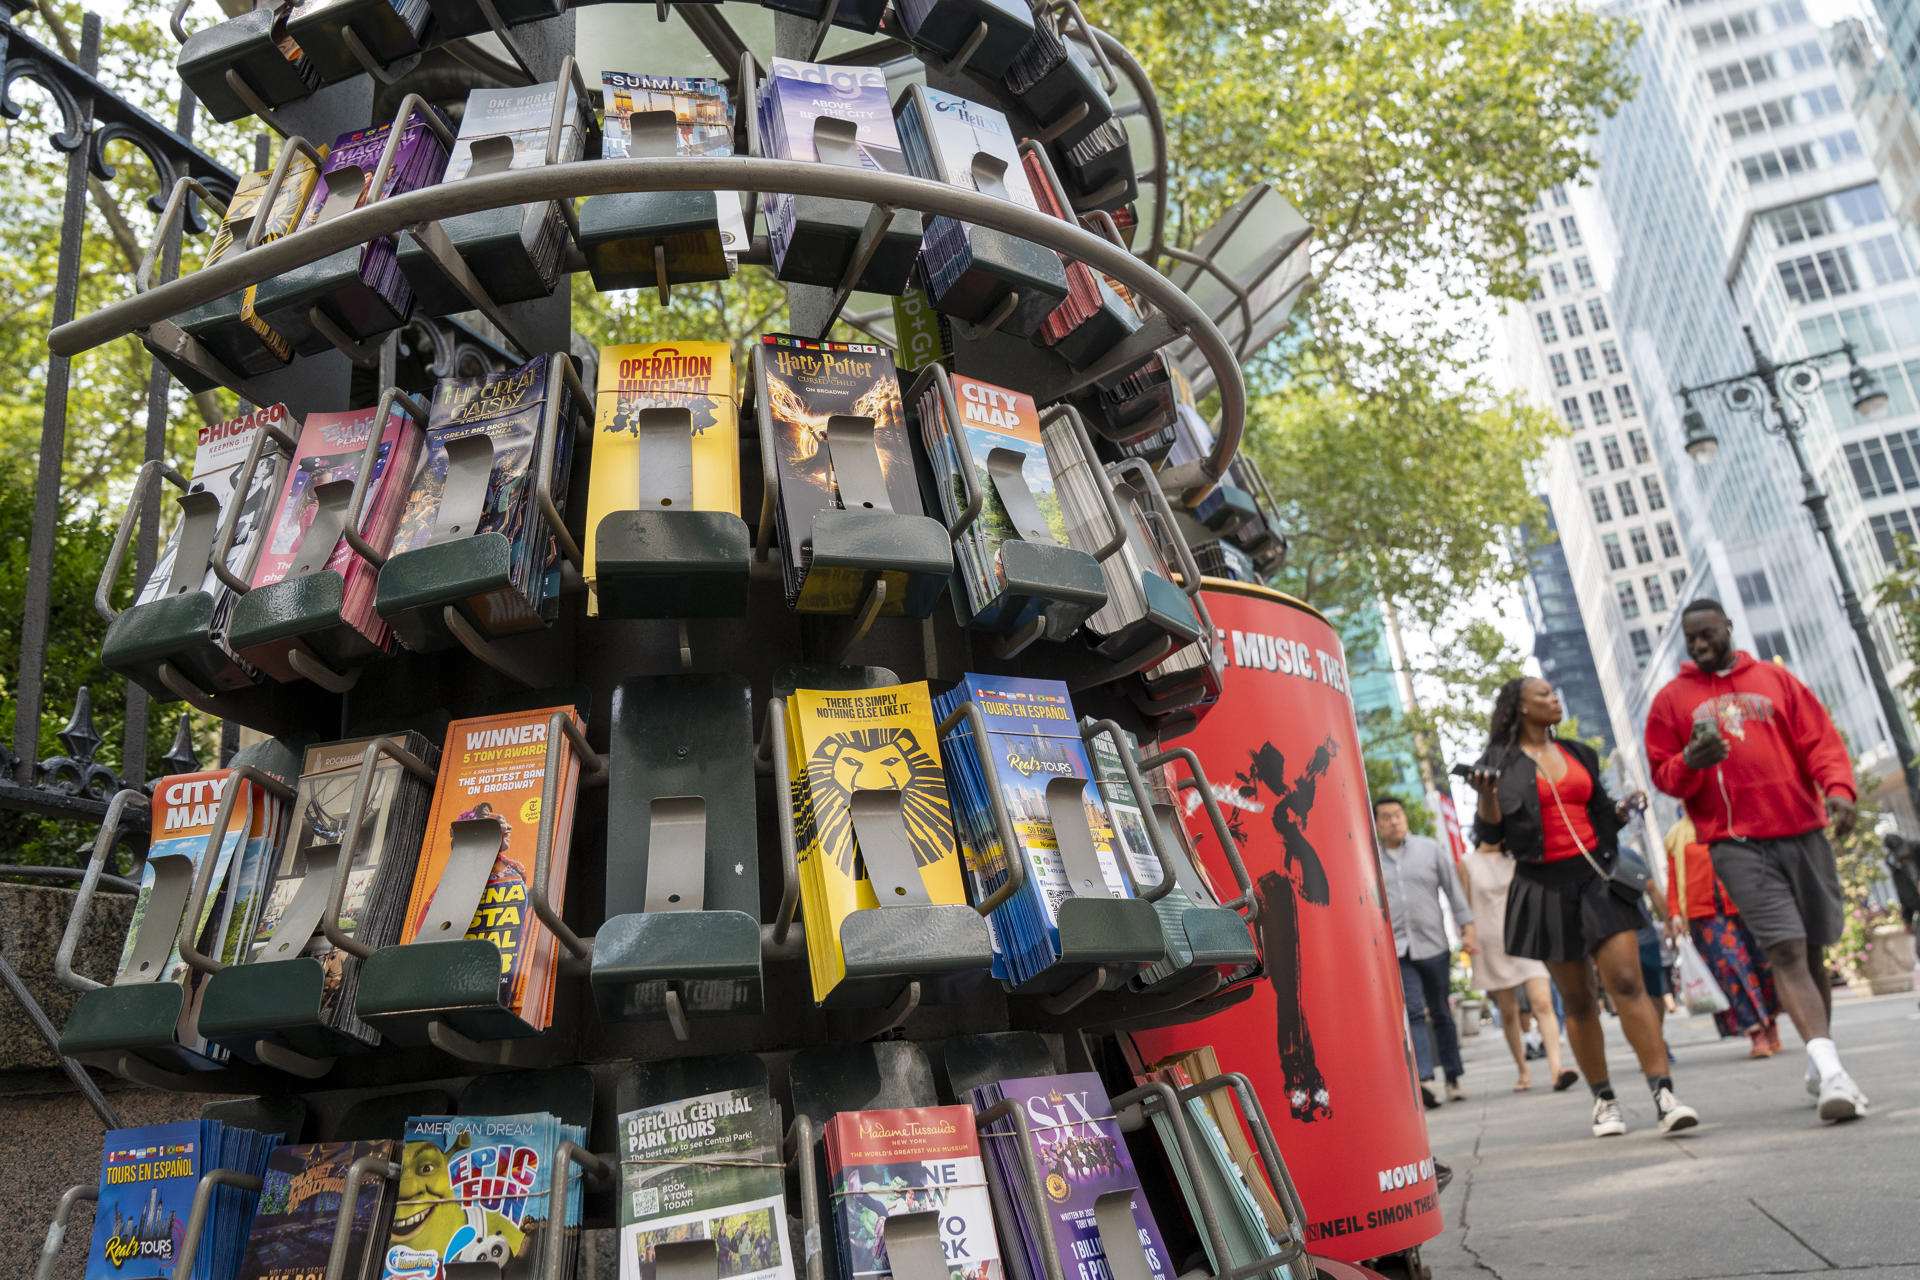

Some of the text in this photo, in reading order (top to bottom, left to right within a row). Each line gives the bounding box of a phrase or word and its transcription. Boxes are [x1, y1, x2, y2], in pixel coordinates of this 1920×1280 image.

[612, 75, 708, 92] SUMMIT
[775, 64, 884, 99] edge
[488, 98, 513, 109] ONE
[812, 99, 853, 110] ABOVE
[847, 110, 875, 119] CITY
[620, 356, 712, 379] OPERATION
[775, 352, 872, 379] Harry Potter
[816, 388, 849, 396] BROADWAY
[830, 378, 857, 387] CHILD
[962, 383, 1017, 411] CITY
[197, 403, 284, 446] CHICAGO
[966, 401, 1020, 430] MAP
[208, 439, 241, 454] KEEPING
[1232, 630, 1319, 682] MUSIC.
[1316, 649, 1346, 694] THE
[855, 697, 863, 707] IS
[865, 694, 898, 707] SIMPLY
[816, 707, 855, 719] NOTHING
[857, 708, 878, 718] ELSE
[880, 705, 899, 717] LIKE
[980, 701, 1071, 721] TOURS EN ESPAÑOL
[463, 753, 471, 764] 5
[474, 748, 502, 762] TONY
[1041, 762, 1072, 774] TOURS
[459, 777, 476, 786] THE
[478, 772, 521, 784] HOTTEST
[468, 780, 535, 795] ON BROADWAY
[165, 778, 229, 805] CITY
[628, 1097, 753, 1136] OFFICIAL CENTRAL
[1026, 1091, 1109, 1147] SIX
[414, 1122, 482, 1136] AMERICAN
[629, 1119, 716, 1153] PARK TOURS
[859, 1120, 956, 1139] Madame Tussauds
[630, 1154, 645, 1162] The
[645, 1149, 662, 1159] best
[663, 1146, 679, 1155] way
[680, 1143, 689, 1151] to
[704, 1135, 732, 1146] Central
[733, 1131, 753, 1142] Park!
[894, 1148, 924, 1156] GREATEST
[942, 1144, 968, 1152] MUSEUM
[107, 1156, 194, 1185] TOURS EN ESPAÑOL
[290, 1163, 335, 1184] PLANET
[448, 1144, 539, 1190] EPIC
[1378, 1162, 1419, 1192] NOW
[662, 1182, 686, 1193] BOOK
[663, 1190, 693, 1202] A TOUR
[461, 1177, 530, 1230] FUN
[664, 1199, 694, 1211] TODAY!
[1320, 1215, 1364, 1239] NEIL
[1366, 1202, 1413, 1229] SIMON
[105, 1235, 172, 1266] Real's TOURS
[1070, 1242, 1079, 1260] 1
